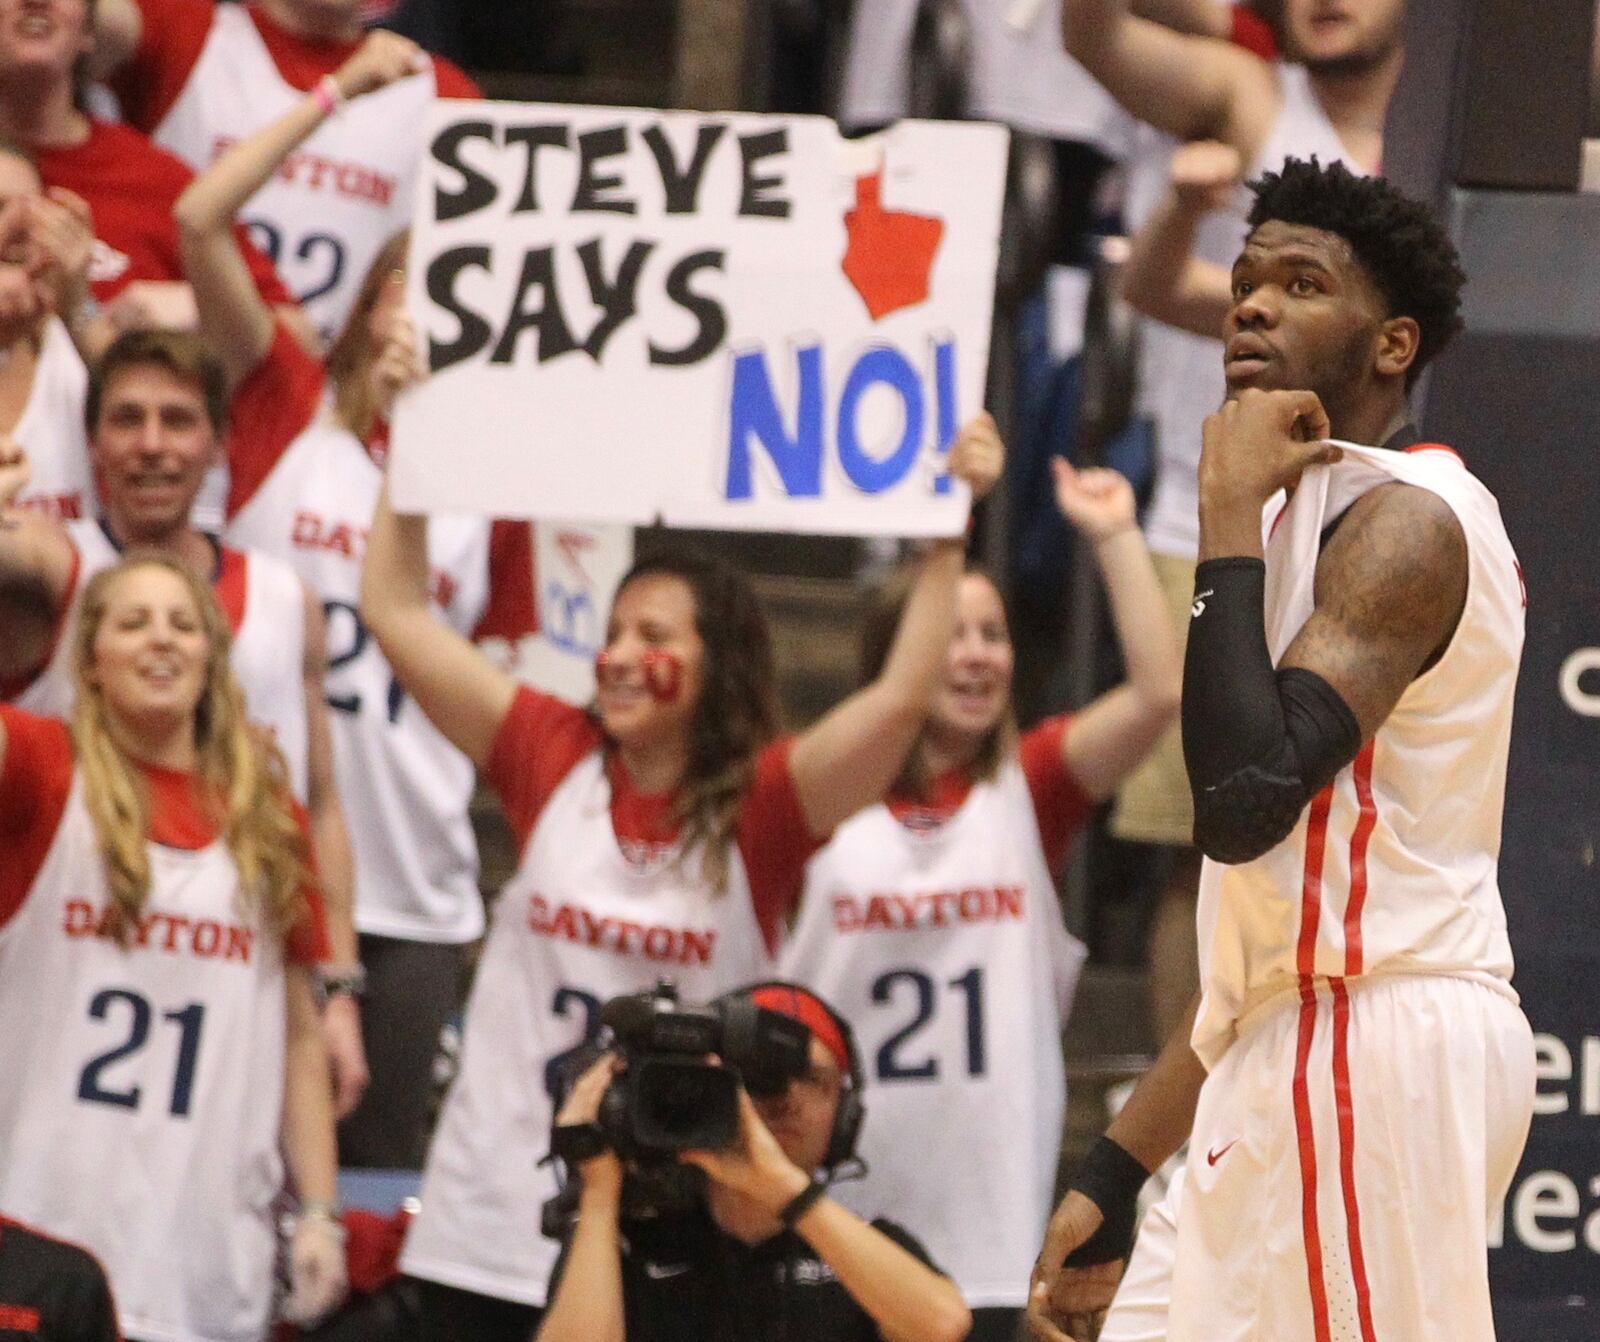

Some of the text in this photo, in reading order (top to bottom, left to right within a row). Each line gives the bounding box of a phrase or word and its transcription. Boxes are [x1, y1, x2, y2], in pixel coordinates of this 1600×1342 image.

[430, 121, 792, 221] STEVE
[426, 237, 728, 374] SAYS
[725, 337, 957, 500] NO!
[530, 892, 720, 966] DAYTON
[832, 885, 1024, 934] DAYTON
[77, 988, 206, 1118] 21
[871, 966, 985, 1081] 21
